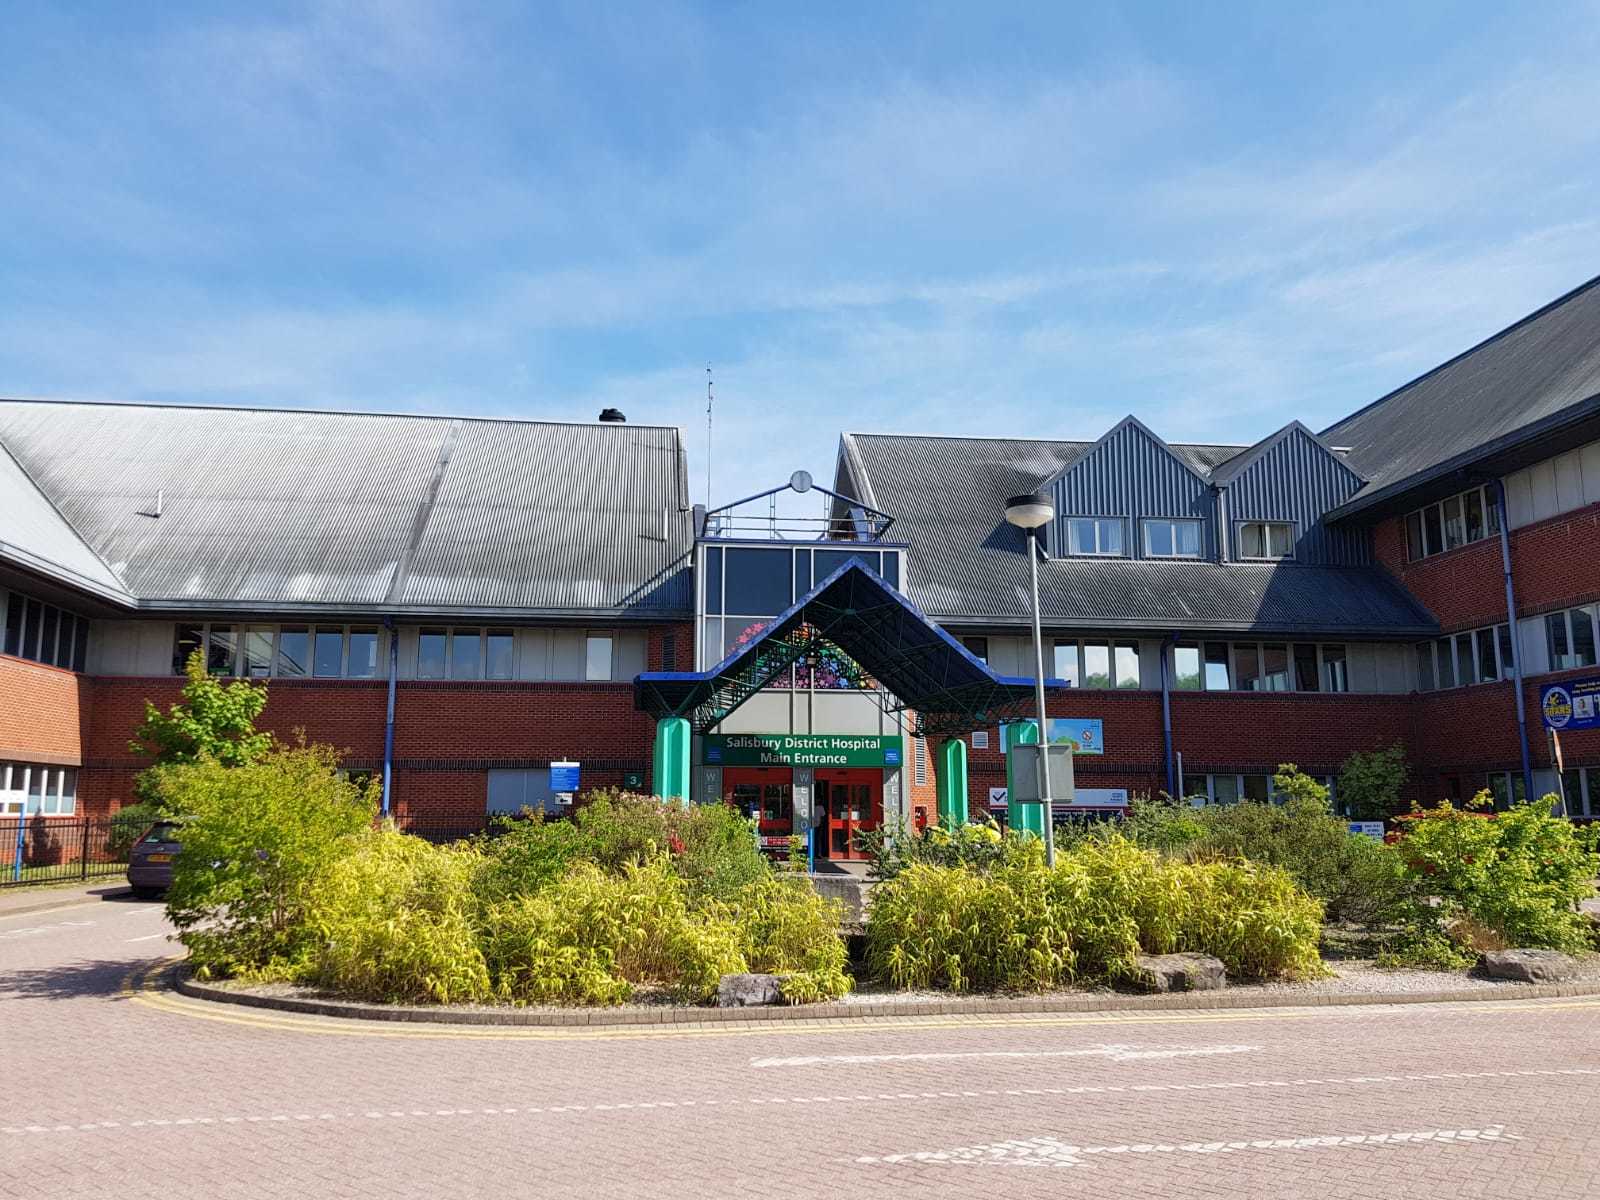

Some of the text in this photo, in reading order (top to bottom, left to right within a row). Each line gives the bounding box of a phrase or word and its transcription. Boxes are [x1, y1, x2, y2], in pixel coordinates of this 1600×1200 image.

[726, 736, 881, 751] Salisbury District Hospital
[760, 752, 847, 764] Main Entrance
[630, 775, 637, 785] 3
